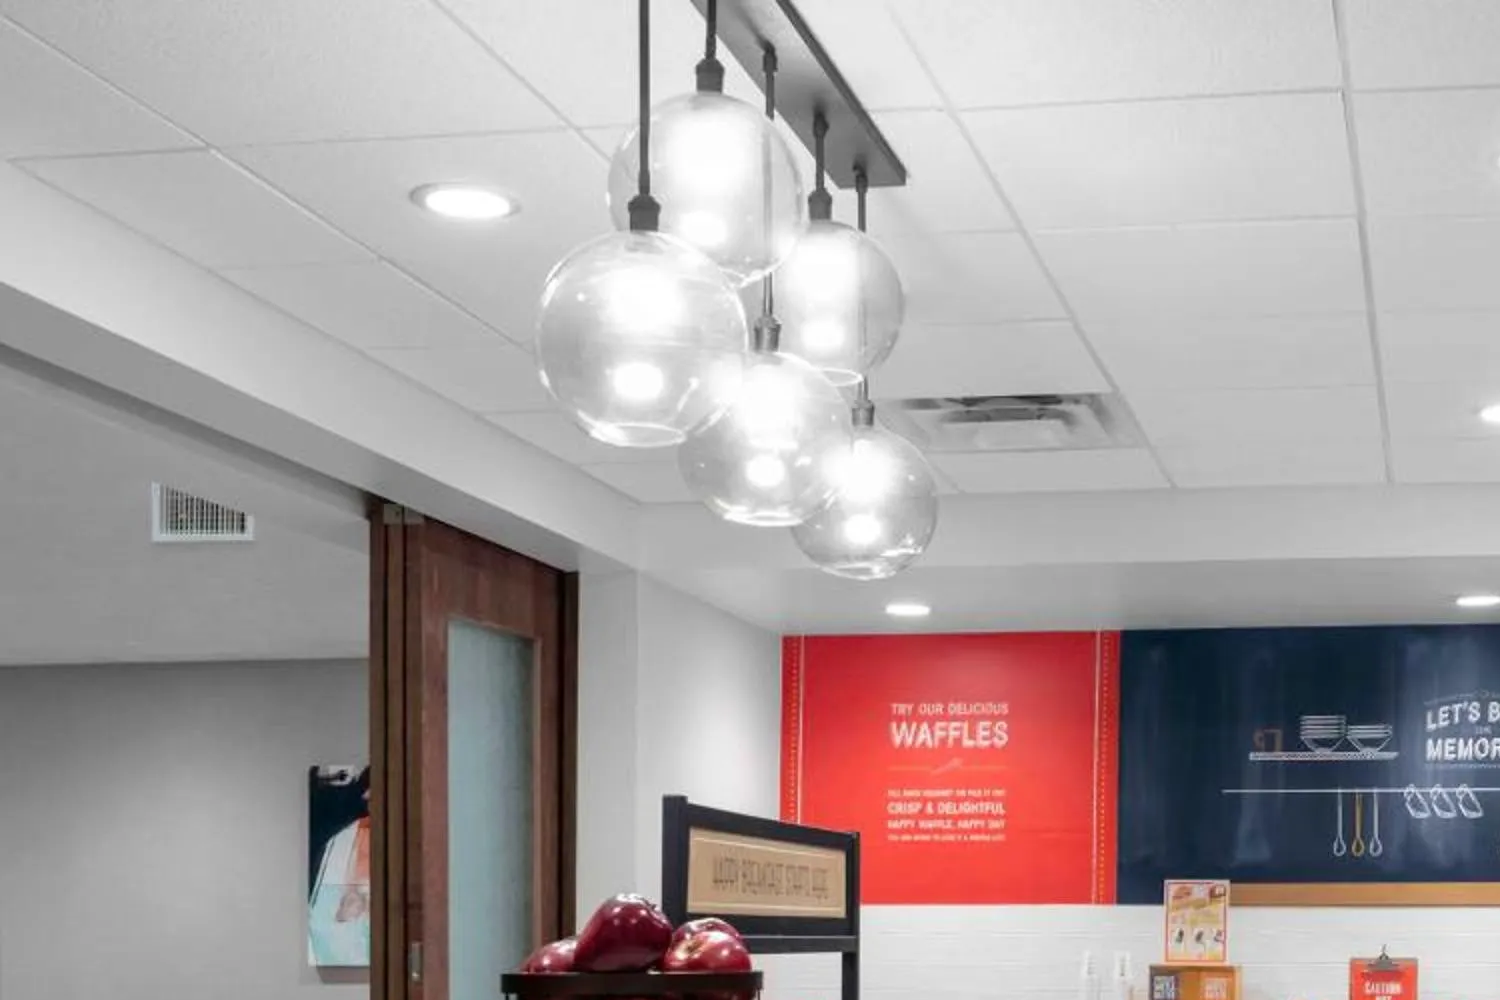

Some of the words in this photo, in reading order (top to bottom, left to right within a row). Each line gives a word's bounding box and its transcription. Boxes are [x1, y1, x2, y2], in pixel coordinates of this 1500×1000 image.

[891, 703, 914, 715] TRY
[919, 703, 944, 715] OUR
[947, 703, 1009, 715] DELICIOUS
[1425, 701, 1481, 732] LET'S
[890, 721, 1009, 748] WAFFLES
[887, 801, 921, 815] CRISP
[938, 801, 1005, 815] DELIGHTFUL
